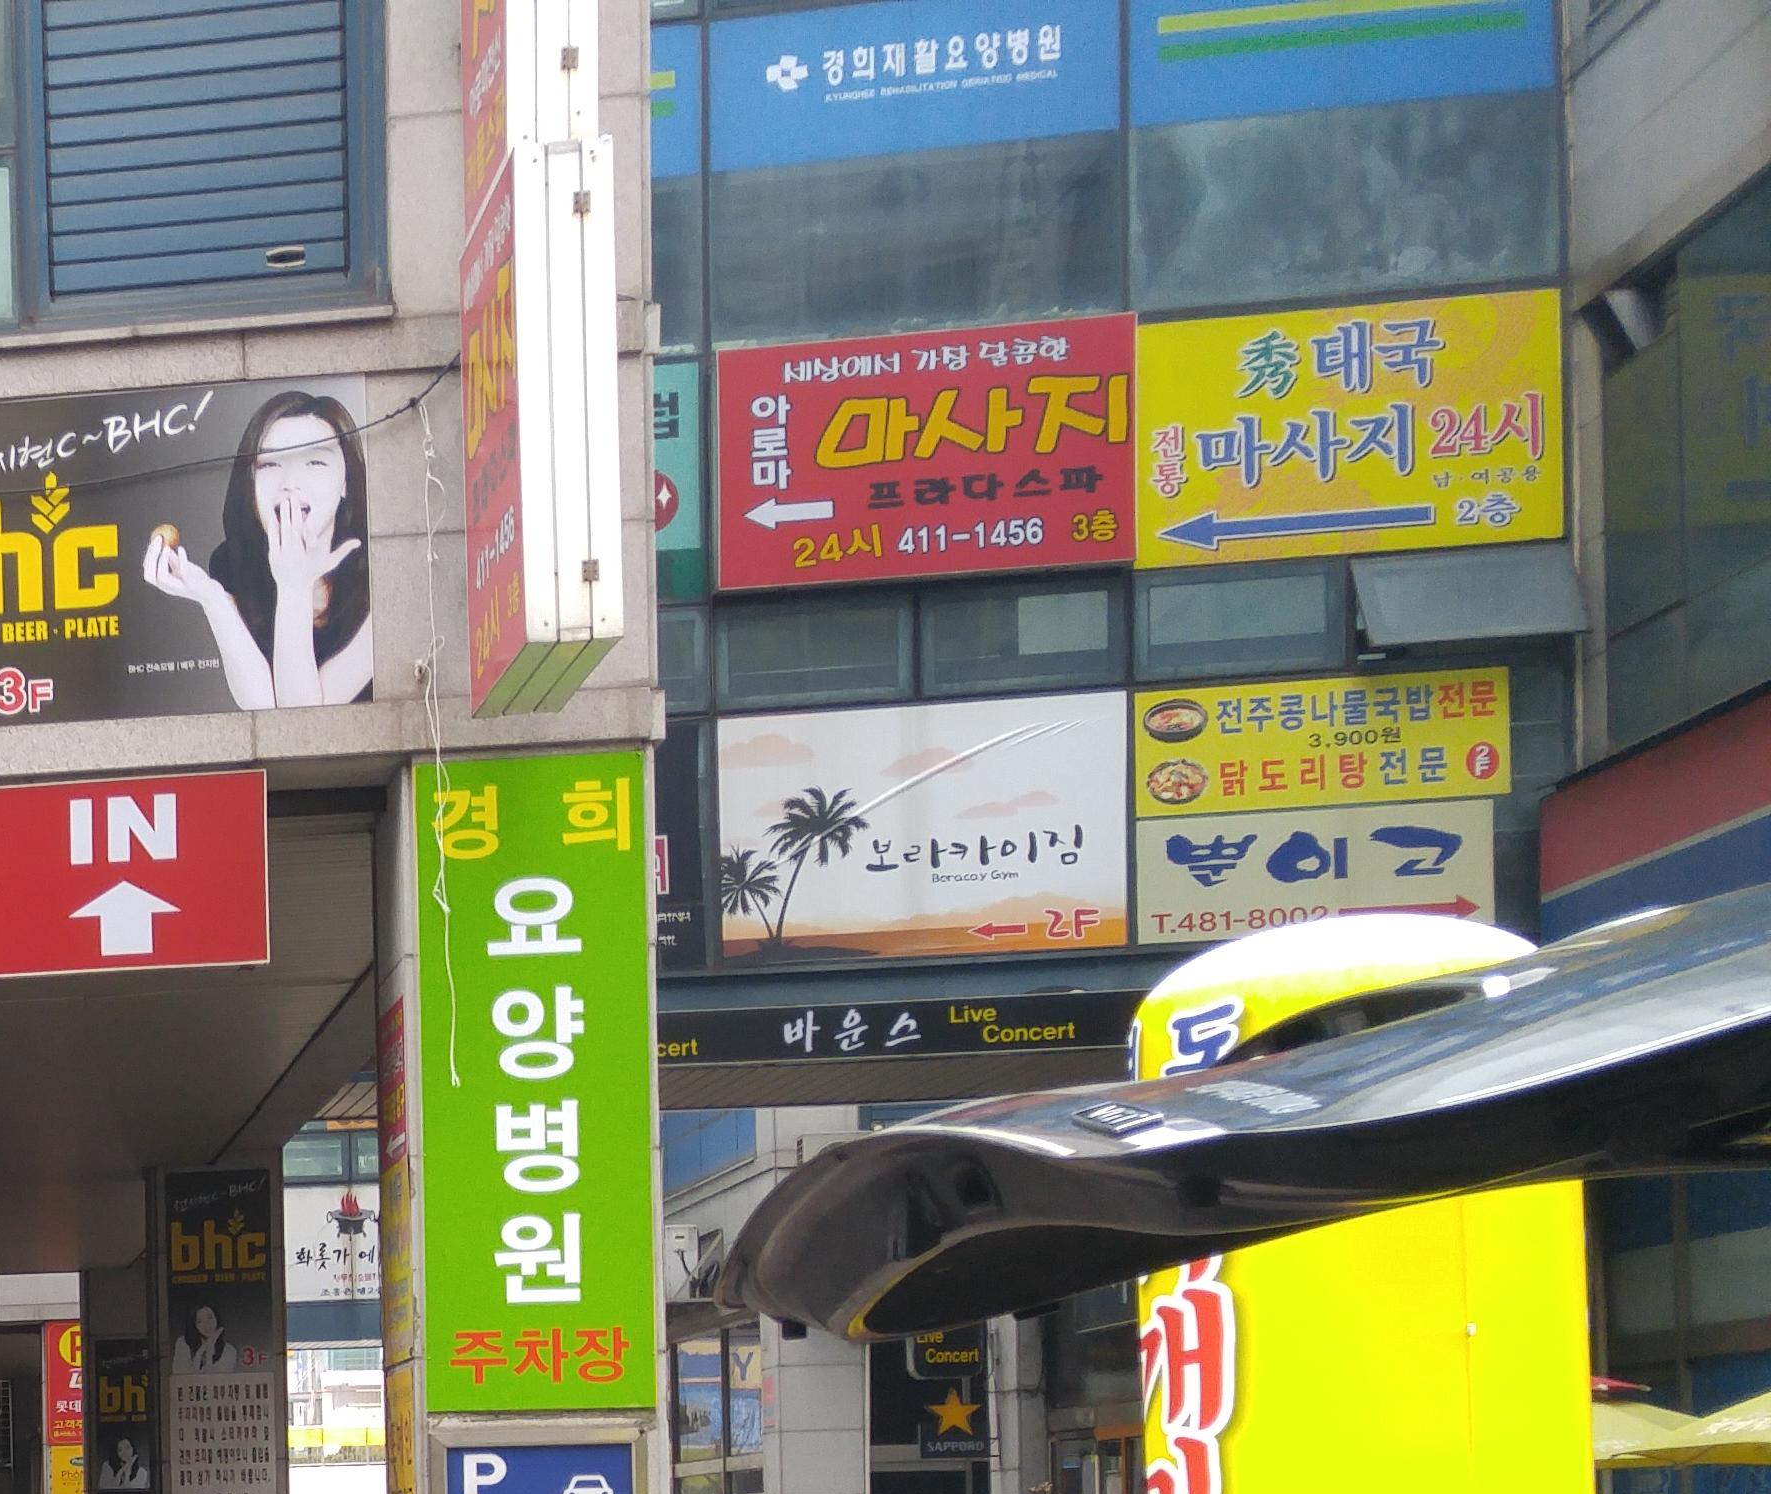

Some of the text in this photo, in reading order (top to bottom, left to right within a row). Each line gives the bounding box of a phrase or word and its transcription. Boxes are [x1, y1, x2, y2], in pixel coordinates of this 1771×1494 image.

[822, 23, 1062, 87] 경희재활요양병원
[784, 335, 1070, 384] 세상에서 가장 달콤한
[1311, 319, 1445, 394] 태국
[750, 394, 792, 490] 아로마
[815, 374, 1129, 469] 마사지
[1195, 392, 1544, 489] 마사지 24시
[867, 464, 1104, 510] 프라다스파
[1152, 425, 1187, 498] 전통
[1457, 493, 1521, 526] 2층
[475, 501, 514, 596] 411-1456
[793, 509, 1119, 568] 24시 411-1456 3층
[2, 620, 49, 643] BEER
[64, 615, 119, 640] PLATE
[1216, 680, 1499, 735] 전주콩나물국밥 전문
[1219, 746, 1448, 797] 닭도리탕 전문
[1474, 744, 1492, 777] 2F
[68, 792, 178, 866] IN
[431, 776, 632, 860] 경희
[865, 824, 1083, 872] 보라카이짐
[1165, 825, 1463, 887] 뿐이고
[931, 868, 1019, 884] Boracay Gym
[1044, 909, 1100, 940] 2F
[783, 1007, 922, 1053] 바운스
[949, 1005, 998, 1024] Live
[982, 1022, 1076, 1044] Concert
[657, 1038, 698, 1059] cert
[485, 876, 584, 1304] 요양병원
[171, 1219, 267, 1272] bhc
[450, 1326, 629, 1384] 주차장
[925, 1347, 980, 1364] Concert
[99, 1375, 148, 1413] bh
